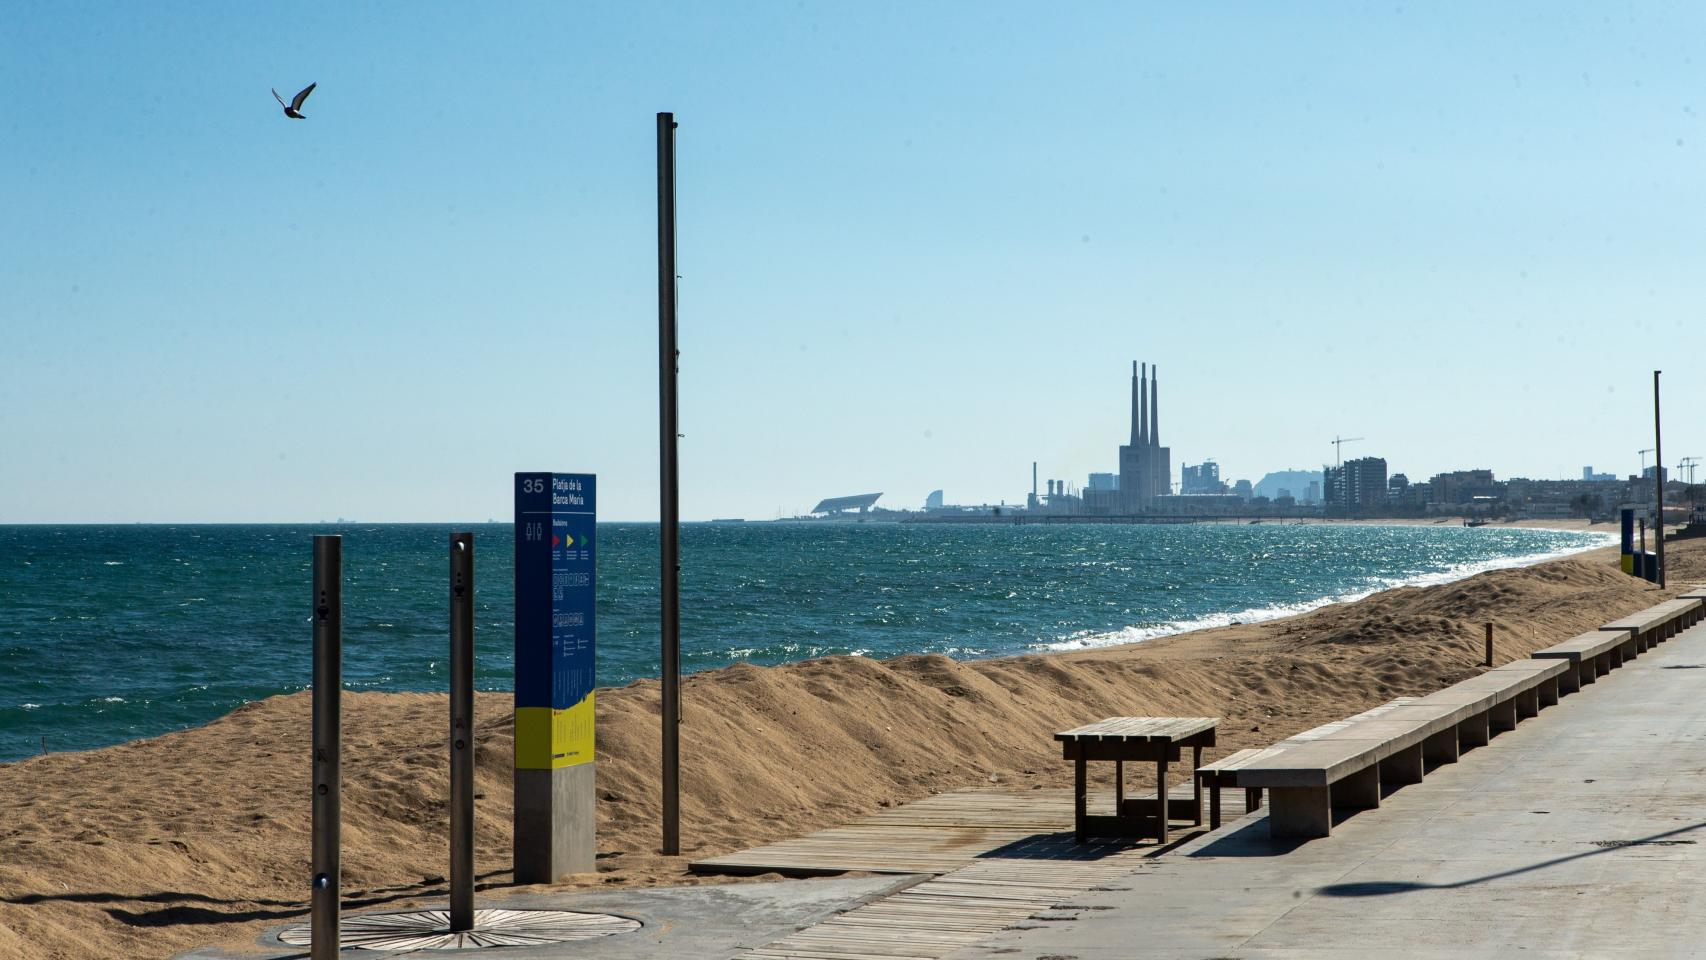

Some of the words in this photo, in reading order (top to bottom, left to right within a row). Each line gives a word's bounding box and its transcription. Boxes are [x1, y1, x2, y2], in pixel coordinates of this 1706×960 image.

[523, 479, 544, 493] 35
[553, 478, 568, 493] Platja
[569, 480, 575, 490] de
[576, 479, 582, 491] la
[553, 493, 568, 504] Barca
